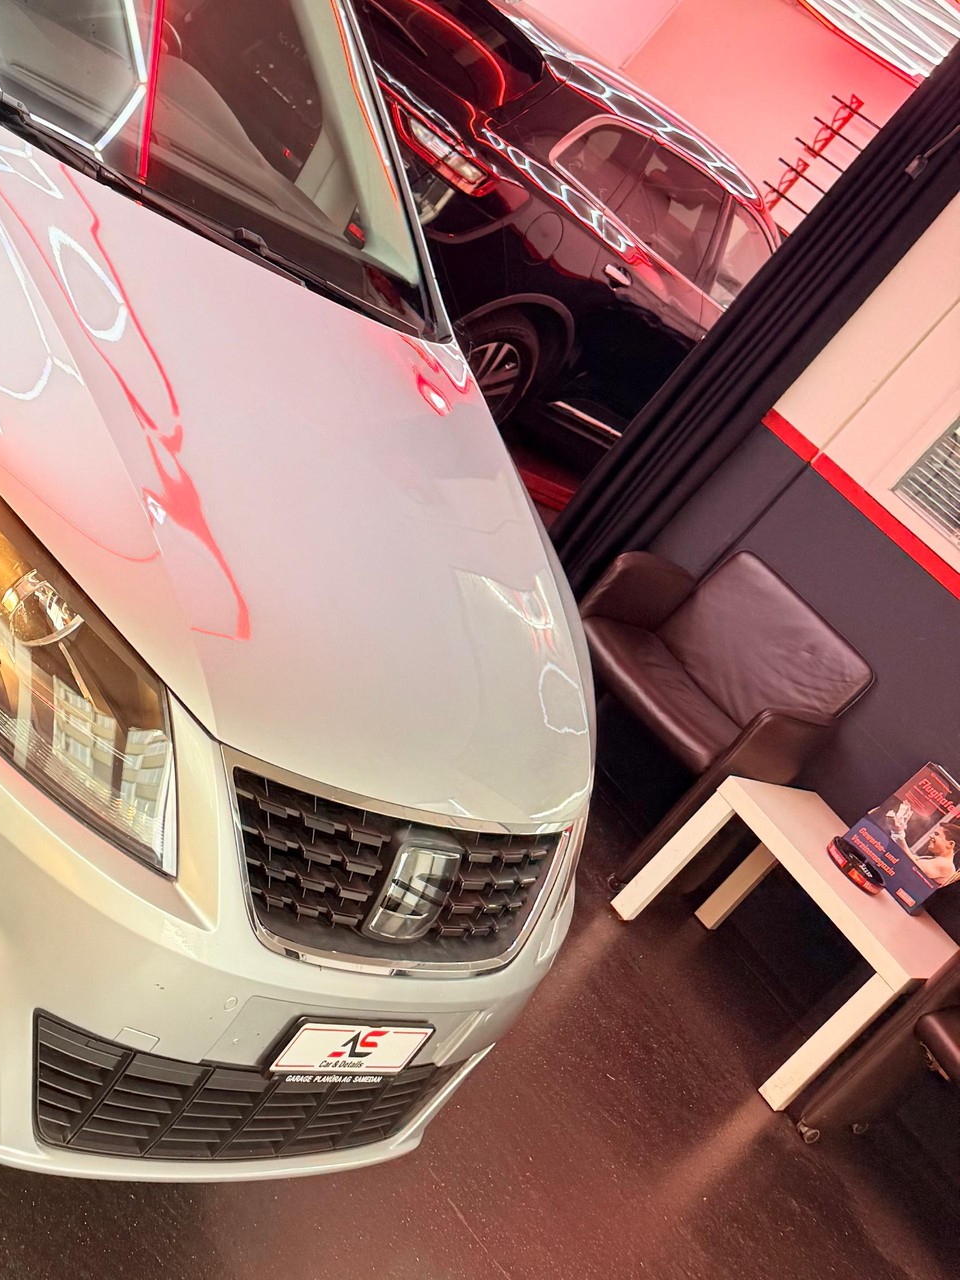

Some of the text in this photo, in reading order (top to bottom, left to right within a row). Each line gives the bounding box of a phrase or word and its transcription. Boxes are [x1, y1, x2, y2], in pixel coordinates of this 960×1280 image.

[918, 778, 960, 819] Flughafe
[851, 834, 896, 877] Vereinsmagazin
[884, 852, 900, 865] und
[318, 1060, 364, 1069] Car & Details
[285, 1074, 314, 1083] GARAGE
[341, 1075, 353, 1083] AG
[352, 1075, 383, 1083] SAMEDAN
